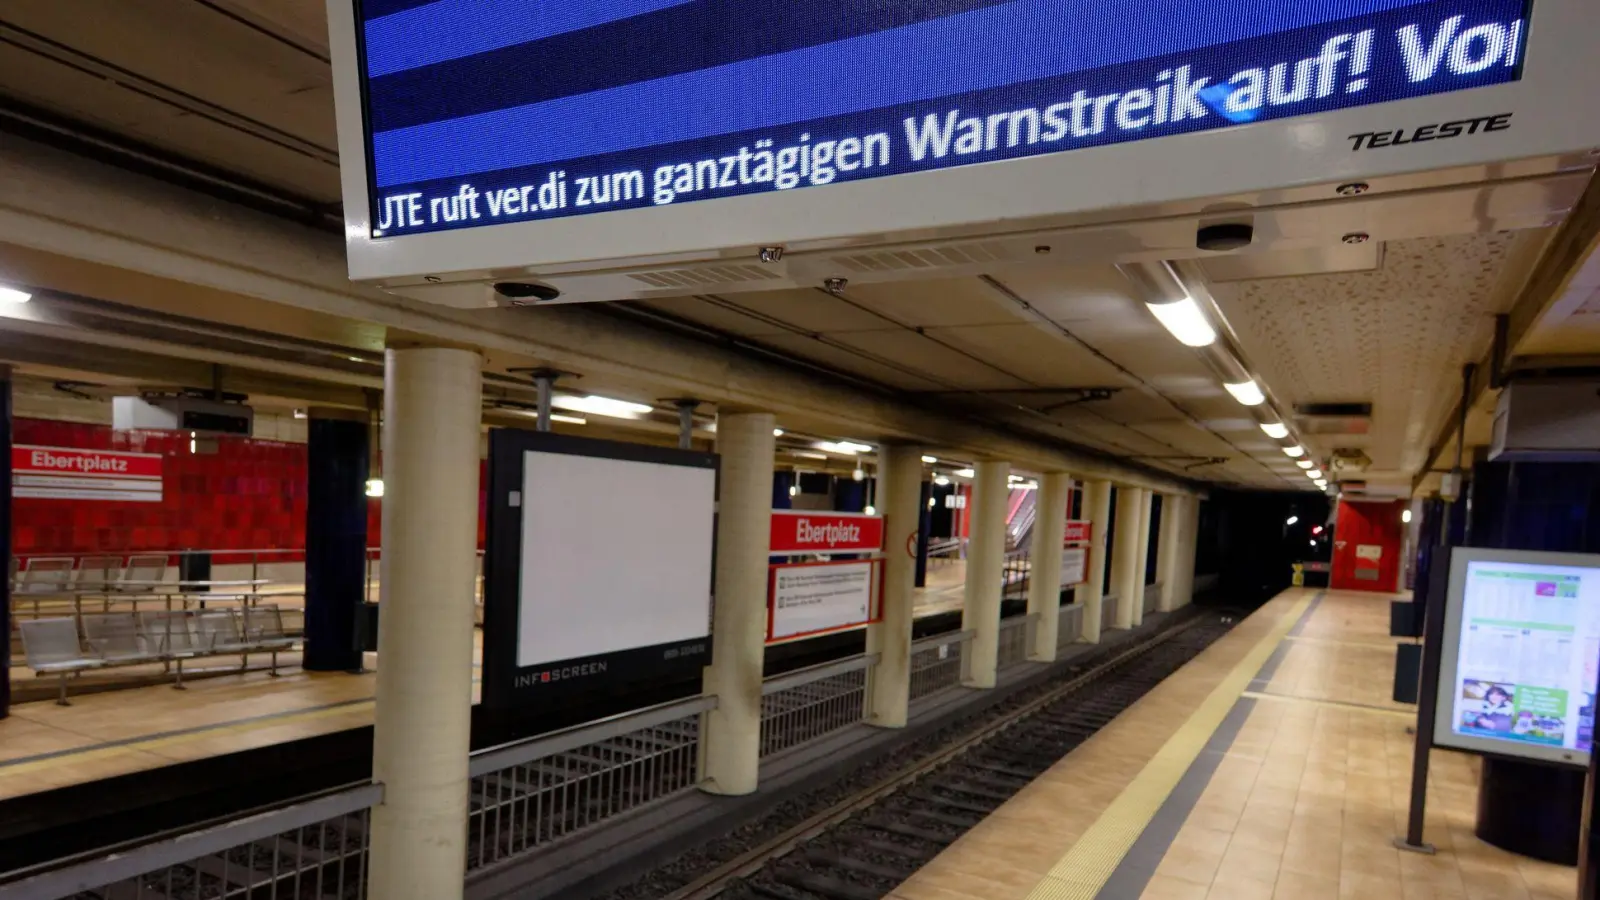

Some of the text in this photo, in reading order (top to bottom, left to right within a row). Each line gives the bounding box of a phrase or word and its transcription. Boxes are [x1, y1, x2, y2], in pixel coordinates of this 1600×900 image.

[430, 183, 481, 224] ruft
[485, 171, 568, 218] ver.di
[574, 169, 645, 206] zum
[652, 132, 890, 206] ganztägigen
[903, 64, 1212, 162] Warnstreik
[1224, 29, 1376, 113] auf!
[1348, 112, 1514, 152] TELESTE
[31, 450, 128, 473] Ebertplatz
[795, 518, 861, 548] Ebertplatz
